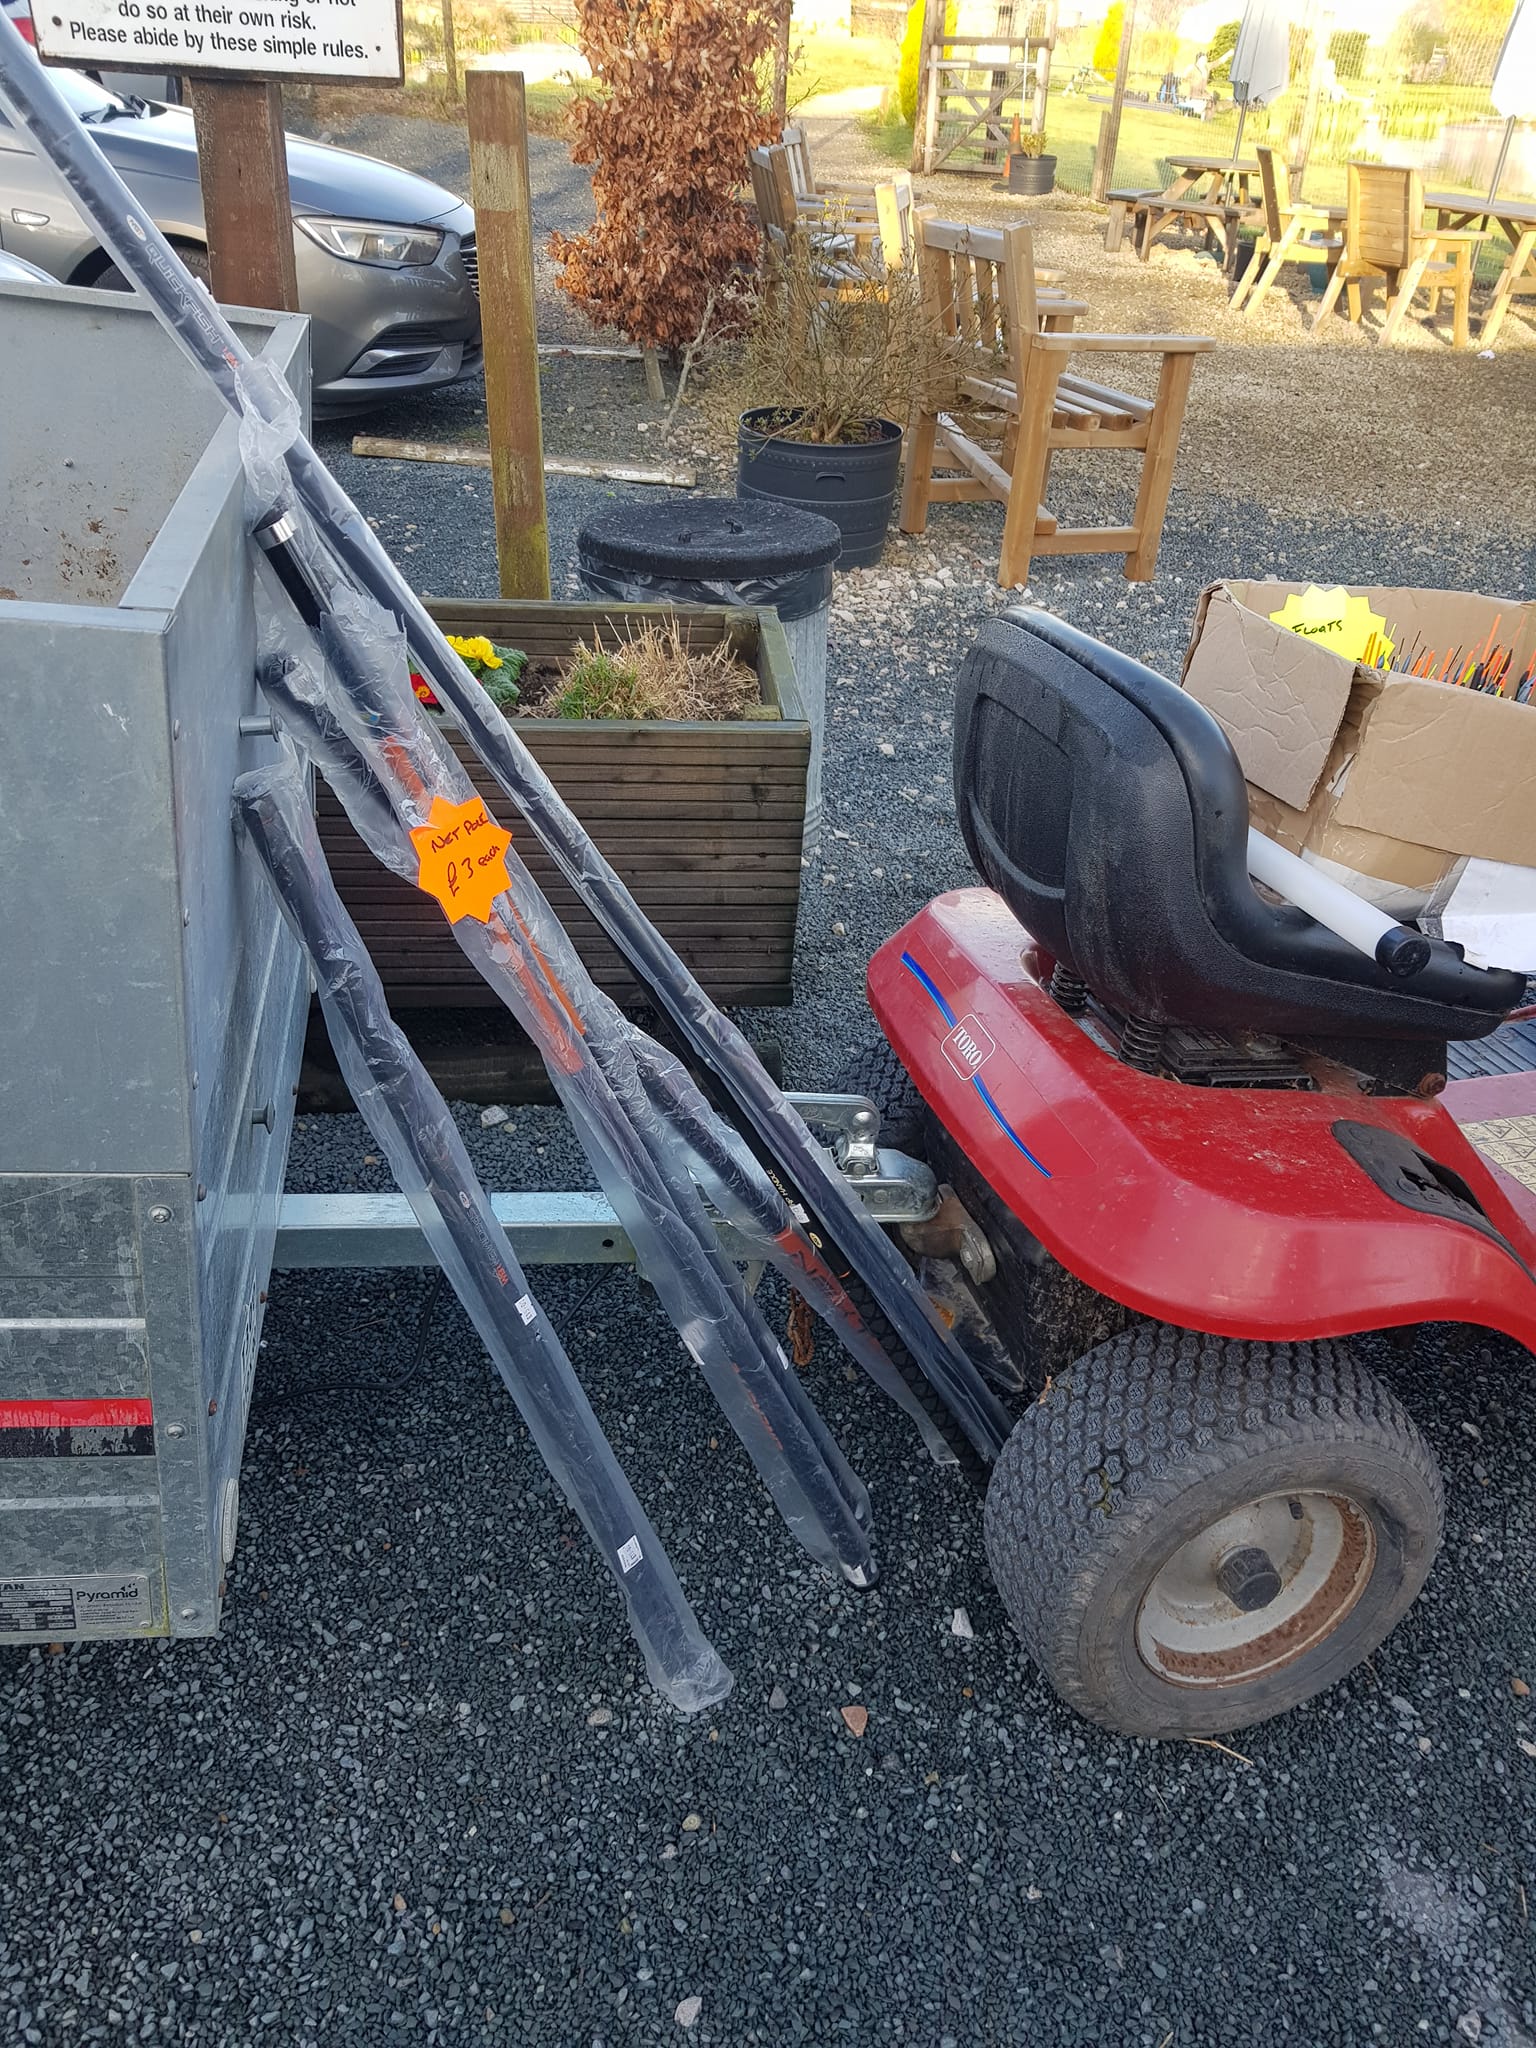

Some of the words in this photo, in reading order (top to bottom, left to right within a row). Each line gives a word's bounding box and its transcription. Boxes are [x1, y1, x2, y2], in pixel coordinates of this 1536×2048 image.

[118, 0, 140, 18] do
[146, 4, 168, 20] so
[173, 4, 191, 22] at
[194, 4, 233, 25] their
[238, 11, 275, 28] own
[280, 10, 317, 30] risk.
[69, 21, 127, 44] Please
[133, 26, 179, 47] abide
[184, 29, 204, 54] by
[210, 32, 257, 52] these
[263, 35, 317, 60] simple
[322, 39, 369, 60] rules.
[430, 826, 460, 854] NET
[447, 857, 474, 898] £3
[952, 1026, 984, 1068] TORO
[76, 1588, 139, 1603] Pyramid
